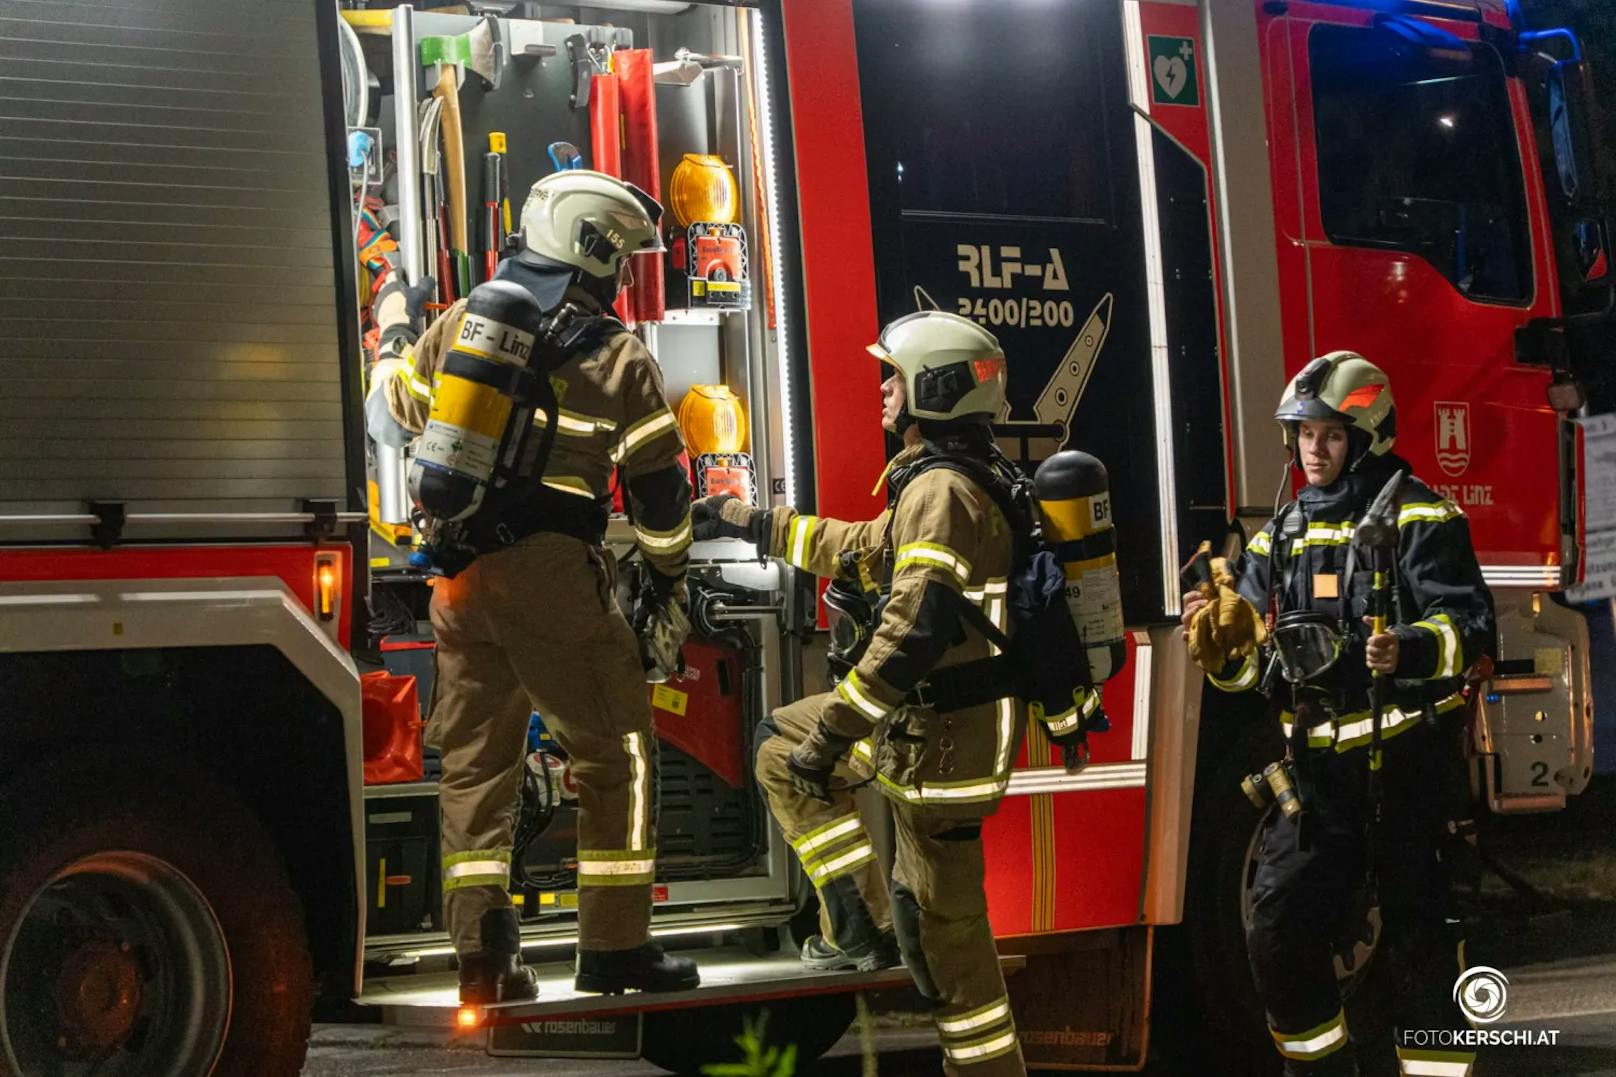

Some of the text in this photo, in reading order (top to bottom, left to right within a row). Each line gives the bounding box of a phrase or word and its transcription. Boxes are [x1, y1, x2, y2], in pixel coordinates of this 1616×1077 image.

[606, 229, 625, 249] 155
[957, 244, 1070, 290] RLF-A
[461, 320, 485, 341] BF
[499, 331, 530, 361] Linz
[1093, 501, 1109, 522] BF
[1531, 761, 1549, 787] 2
[544, 1018, 617, 1035] rosenbauer
